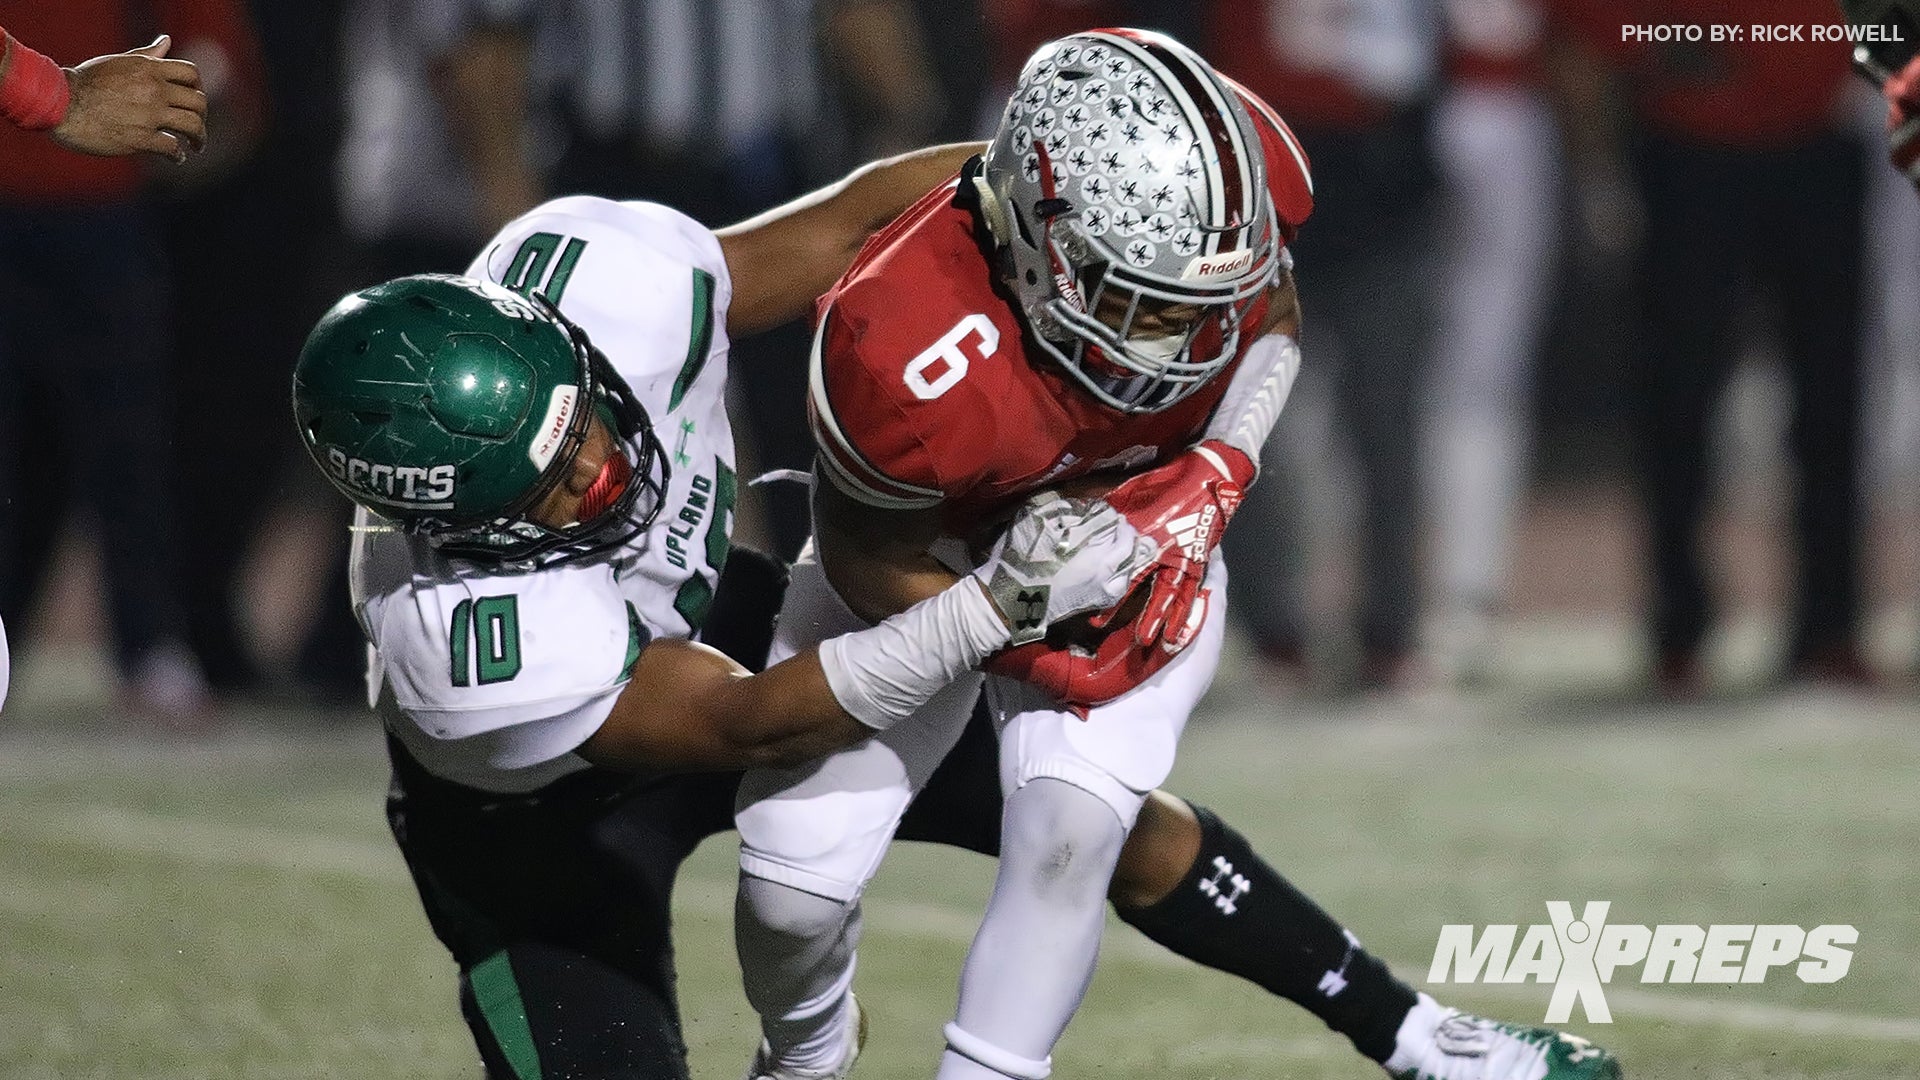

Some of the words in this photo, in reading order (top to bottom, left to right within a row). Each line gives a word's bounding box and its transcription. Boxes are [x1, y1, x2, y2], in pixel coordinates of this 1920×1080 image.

[500, 231, 590, 307] 10
[1198, 252, 1251, 276] Riddell
[903, 313, 1000, 400] 6
[327, 448, 456, 501] SCOTS
[666, 474, 713, 571] UPLAND
[449, 593, 523, 688] 10
